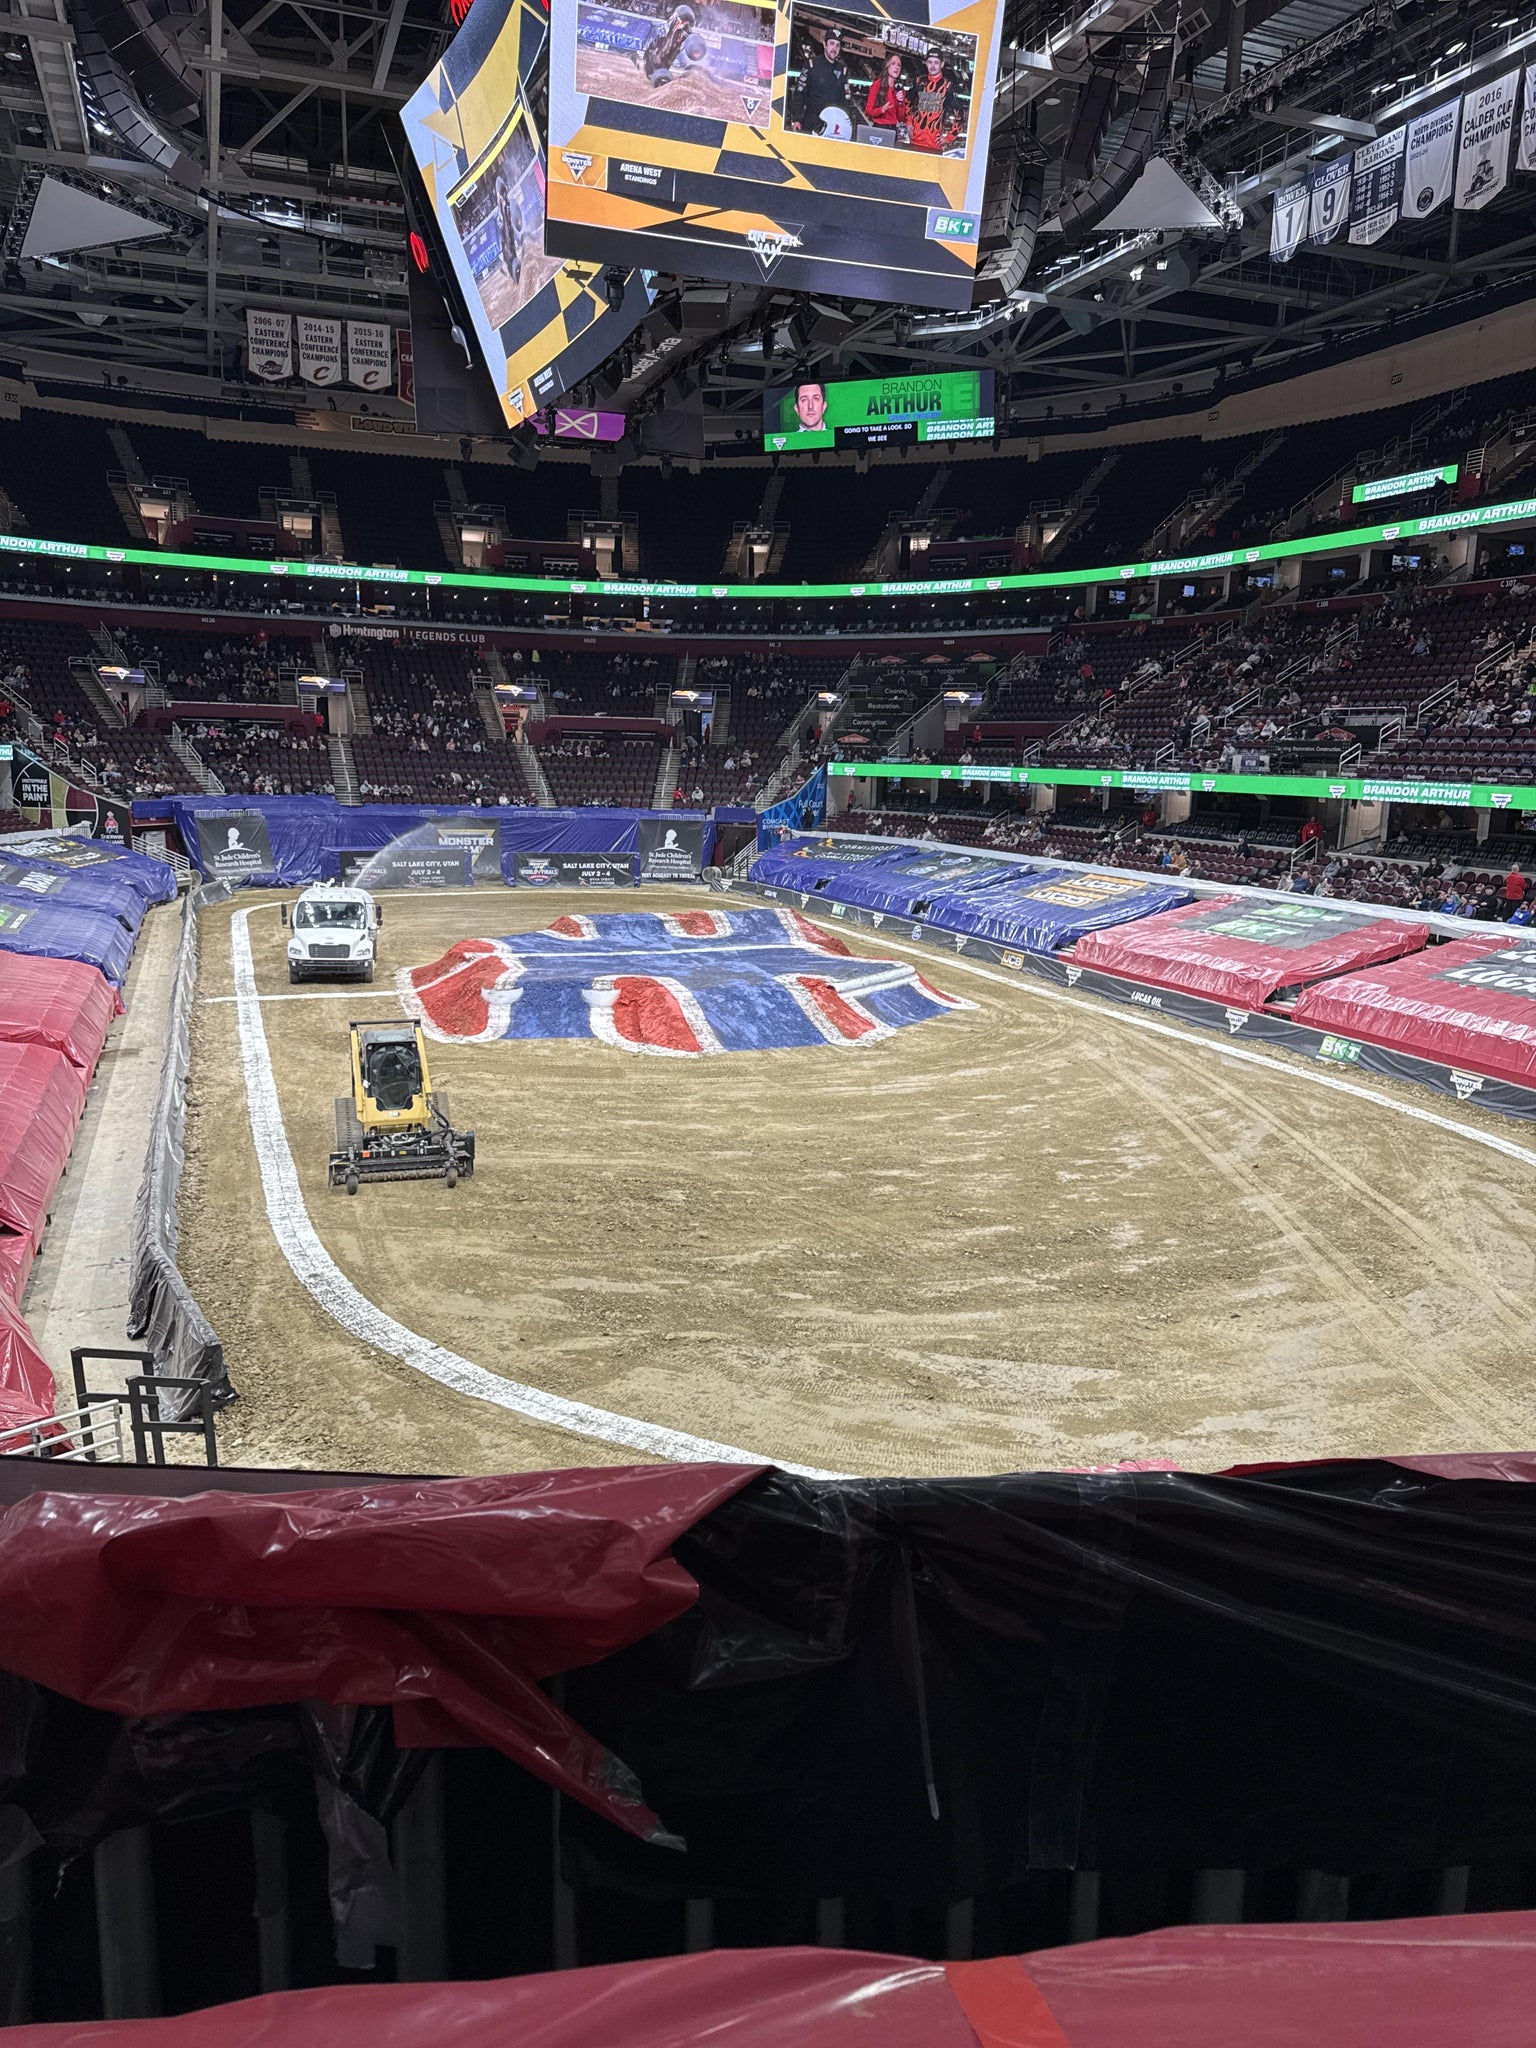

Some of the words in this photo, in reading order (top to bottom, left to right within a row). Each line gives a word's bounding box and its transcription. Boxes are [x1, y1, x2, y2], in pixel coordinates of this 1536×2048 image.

[1479, 87, 1502, 109] 2016
[1464, 108, 1495, 134] CALDER
[1496, 99, 1513, 118] CUP
[1414, 124, 1429, 137] NORTH
[1430, 112, 1452, 130] DIVISION
[1411, 121, 1454, 150] CHAMPIONS
[1463, 117, 1511, 150] CHAMPIONS
[1356, 130, 1404, 160] CLEVELAND
[1363, 145, 1396, 167] BARONS
[620, 163, 643, 174] ARENA
[643, 166, 662, 177] WEST
[1314, 164, 1349, 188] GLOVER
[624, 174, 658, 185] STANDINGS
[1277, 186, 1307, 206] BOWER
[1322, 187, 1336, 225] 9
[935, 218, 973, 234] BKT
[1285, 206, 1294, 243] 1
[253, 316, 285, 327] 2006-07
[254, 328, 284, 338] EASTERN
[304, 323, 335, 334] 2014-15
[353, 327, 384, 338] 2015-16
[250, 337, 290, 349] CONFERENCE
[305, 334, 333, 344] EASTERN
[355, 338, 383, 348] EASTERN
[252, 346, 289, 358] CHAMPIONS
[301, 343, 339, 354] CONFERENCE
[350, 347, 388, 358] CONFERENCE
[302, 352, 338, 363] CHAMPIONS
[352, 357, 387, 368] CHAMPIONS
[882, 379, 942, 394] BRANDON
[866, 390, 942, 416] ARTHUR
[843, 427, 861, 435] GOING
[868, 425, 882, 433] TAKE
[927, 422, 974, 433] BRANDON
[976, 420, 994, 431] ART
[926, 431, 974, 441] BRANDON
[975, 429, 994, 438] ART
[1364, 480, 1406, 495] BRANDON
[1418, 511, 1480, 531] BRANDON
[1482, 502, 1536, 520] ARTHUR
[39, 540, 88, 555] ARTHUR
[1150, 558, 1199, 572] BRANDON
[1199, 553, 1233, 567] ARTHUR
[306, 565, 363, 577] BRANDON
[364, 568, 409, 580] ARTHUR
[603, 584, 654, 593] BRANDON
[656, 584, 696, 594] ARTHUR
[882, 582, 931, 592] BRANDON
[933, 581, 972, 591] ARTHUR
[343, 624, 399, 640] Huntington
[409, 630, 456, 642] LEGENDS
[458, 632, 486, 643] CLUB
[961, 768, 989, 777] BRANDON
[989, 769, 1012, 778] ARTHUR
[1122, 775, 1158, 784] BRANDON
[1159, 776, 1191, 785] ARTHUR
[22, 784, 31, 792] IN
[32, 784, 48, 792] THE
[1363, 785, 1419, 797] BRANDON
[1420, 788, 1471, 800] ARTHUR
[22, 793, 48, 802] PAINT
[438, 837, 494, 846] MONSTER
[239, 859, 262, 868] Hospital
[1003, 955, 1023, 967] JCB
[1131, 990, 1152, 1004] LUCAS
[1151, 996, 1162, 1007] OIL
[1321, 1037, 1361, 1061] BKT
